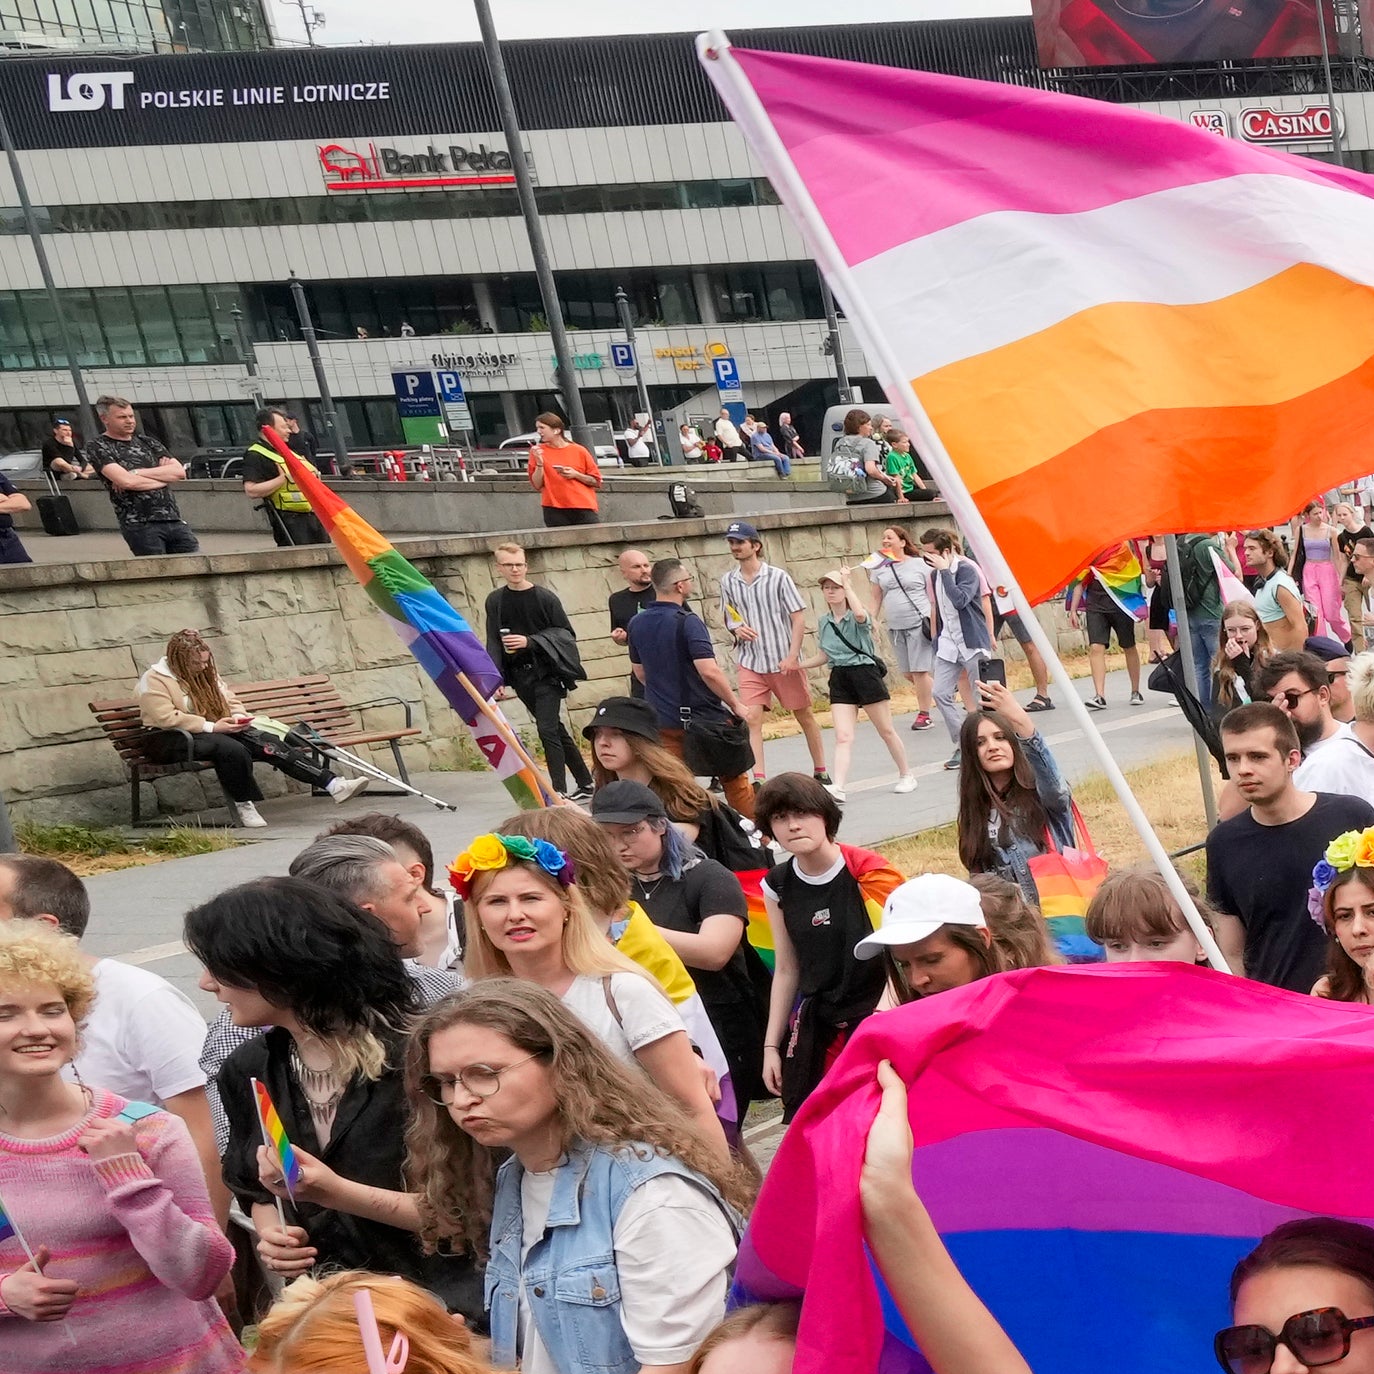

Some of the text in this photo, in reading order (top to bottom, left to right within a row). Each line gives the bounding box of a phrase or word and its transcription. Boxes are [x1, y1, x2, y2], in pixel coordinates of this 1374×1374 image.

[48, 71, 390, 111] LOT POLSKIE LINIE LOTNICZE
[1243, 109, 1333, 137] CASINO
[380, 143, 513, 174] Bank Peka
